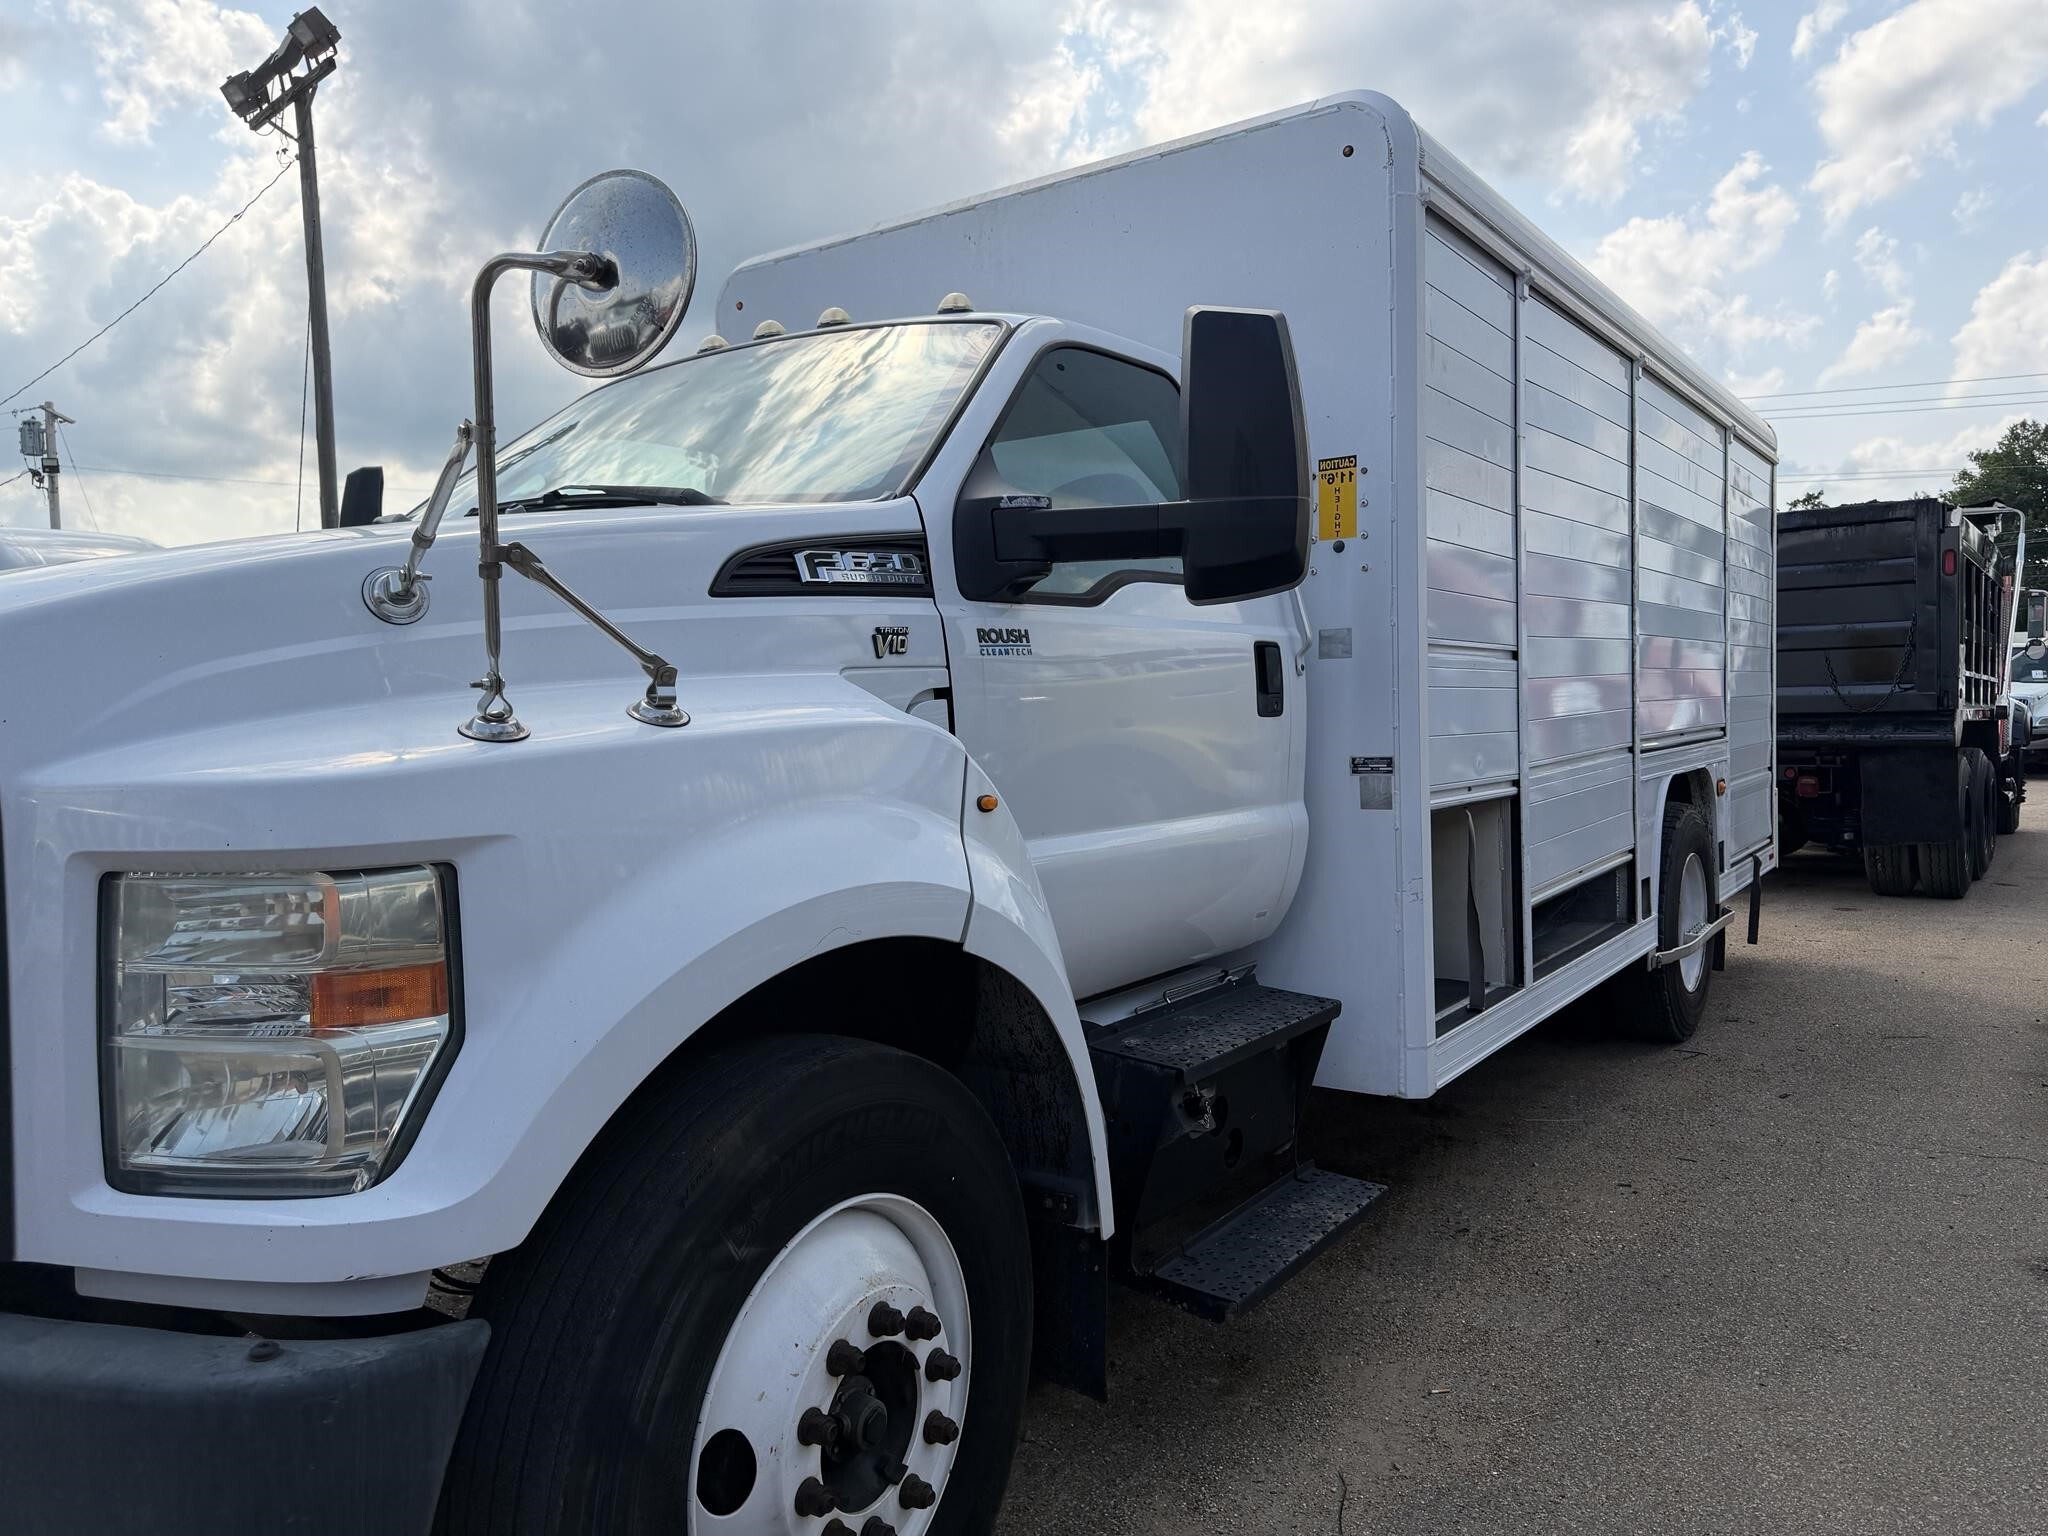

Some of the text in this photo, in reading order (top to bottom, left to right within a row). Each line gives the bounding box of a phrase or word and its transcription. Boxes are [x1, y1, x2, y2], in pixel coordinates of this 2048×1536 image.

[880, 626, 910, 634] TRITON
[976, 627, 1031, 644] ROUSH
[873, 634, 908, 658] V10
[979, 647, 1033, 656] CLEANTECH
